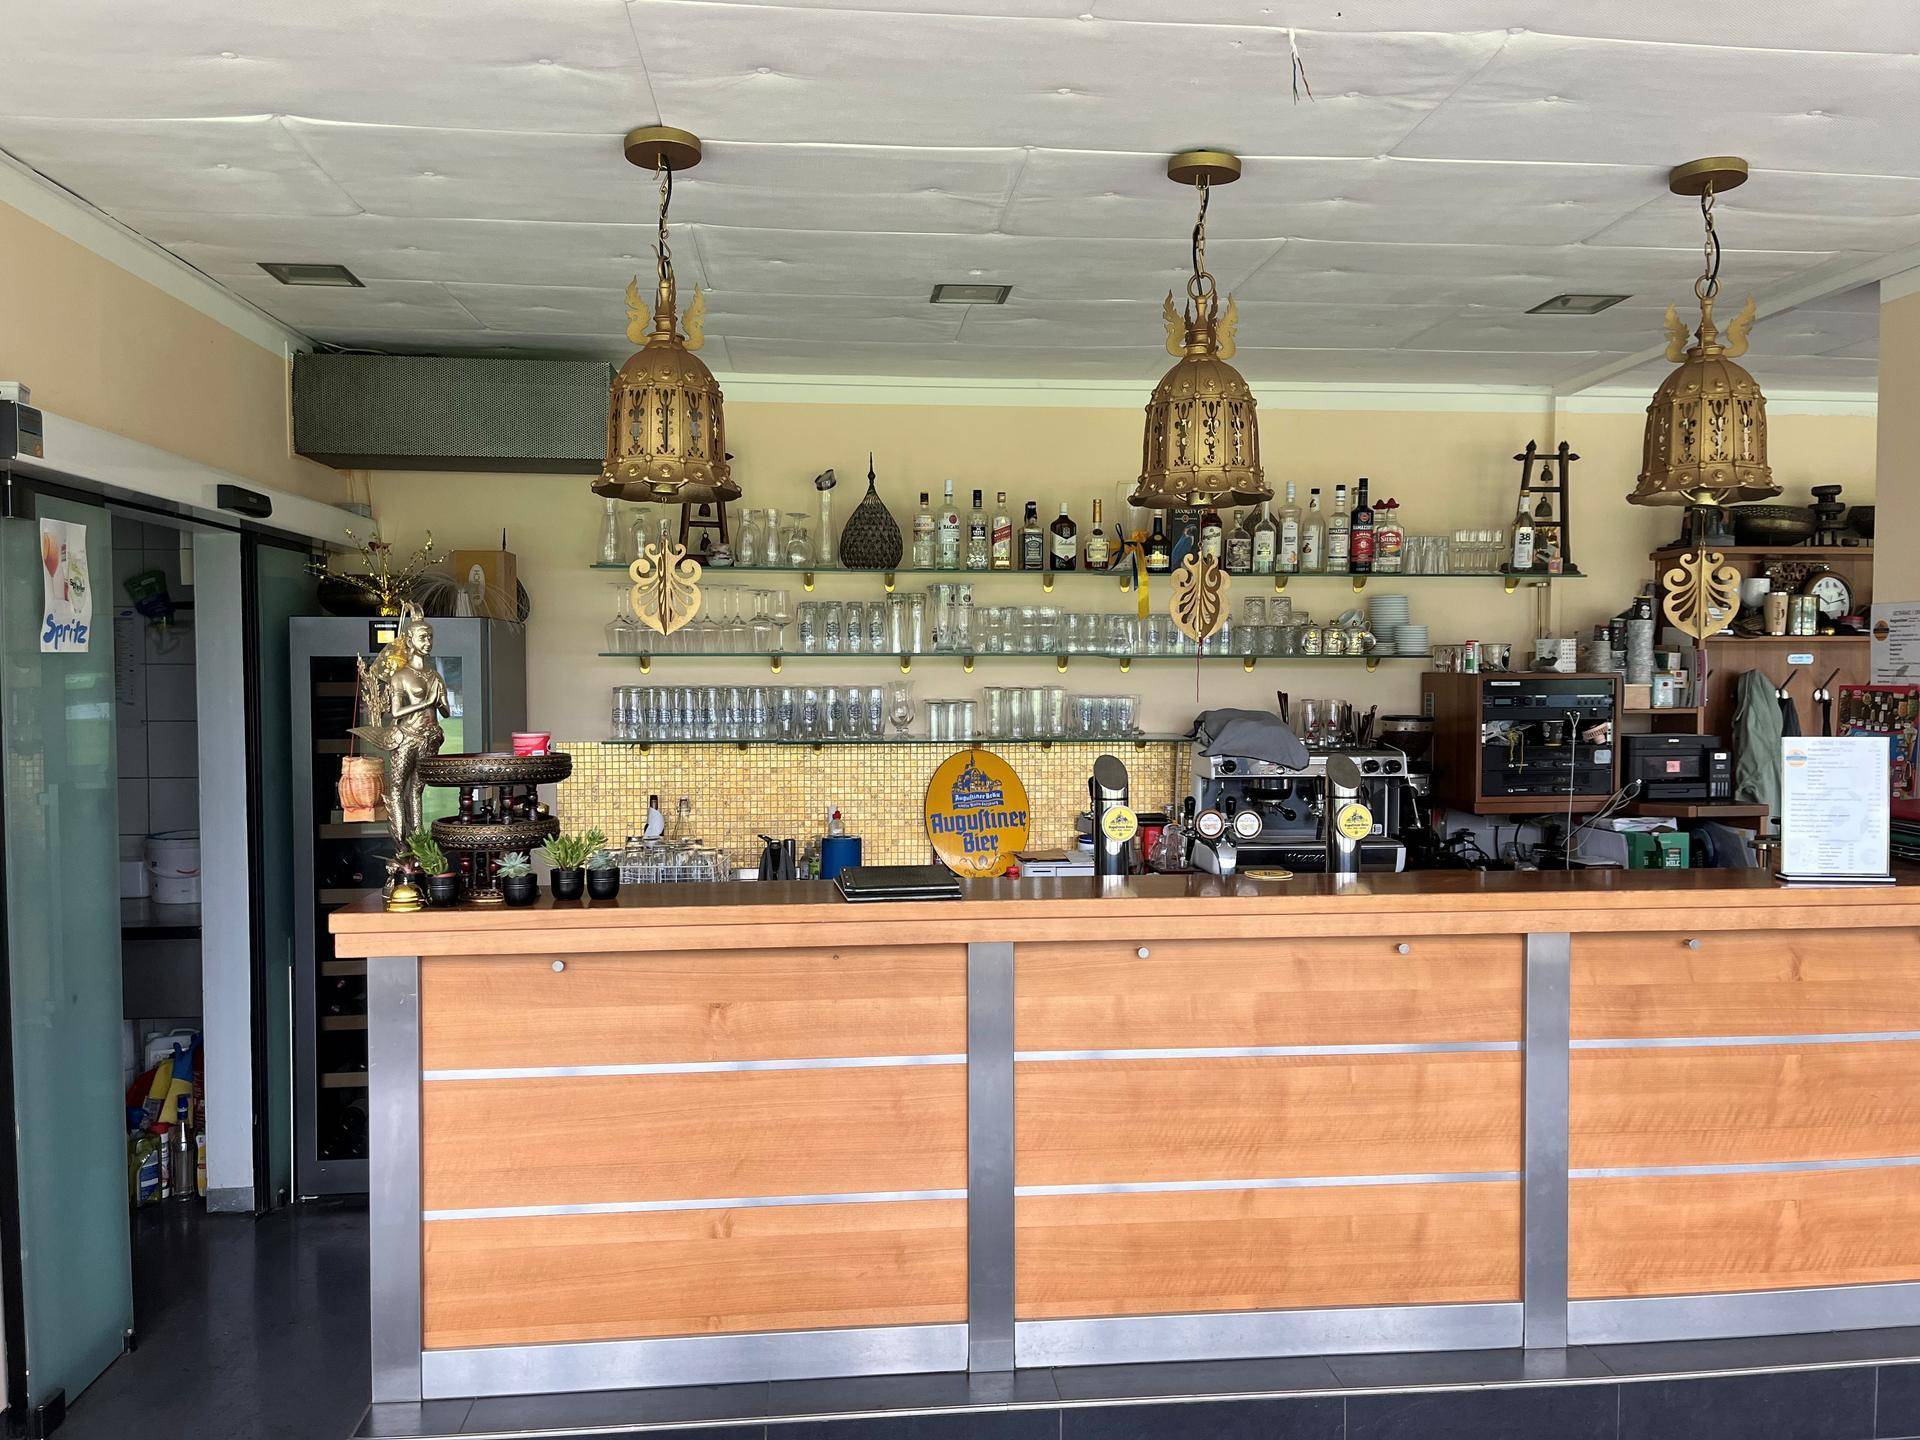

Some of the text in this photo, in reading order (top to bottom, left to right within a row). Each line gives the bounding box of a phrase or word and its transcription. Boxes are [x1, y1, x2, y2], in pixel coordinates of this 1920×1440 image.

[1519, 533, 1531, 541] 38
[42, 612, 88, 651] Spritz
[962, 832, 999, 855] Bier
